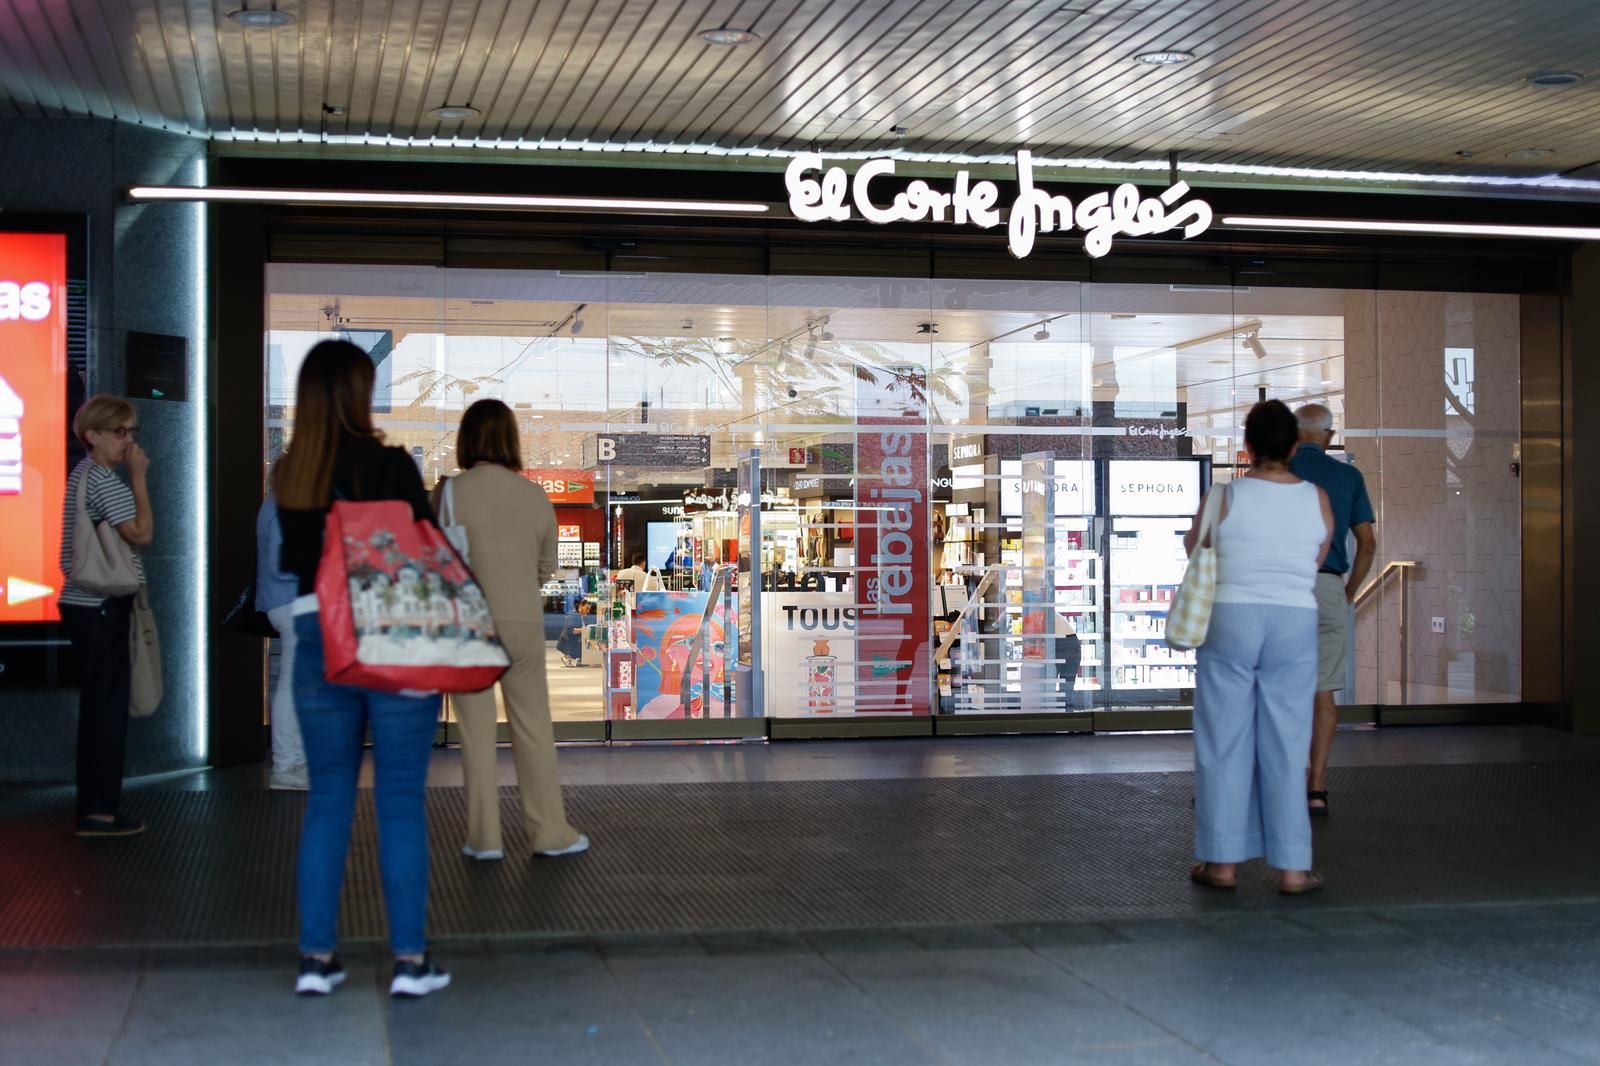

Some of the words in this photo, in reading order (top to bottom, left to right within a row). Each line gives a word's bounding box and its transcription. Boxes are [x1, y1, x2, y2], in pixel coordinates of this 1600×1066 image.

[785, 151, 850, 222] El
[853, 159, 1000, 229] Corte
[1008, 150, 1212, 259] Inglés
[598, 438, 616, 461] B
[953, 443, 982, 460] SEPHORA
[1121, 483, 1184, 493] SEPHORA
[871, 432, 922, 614] rebajas
[862, 577, 879, 615] las
